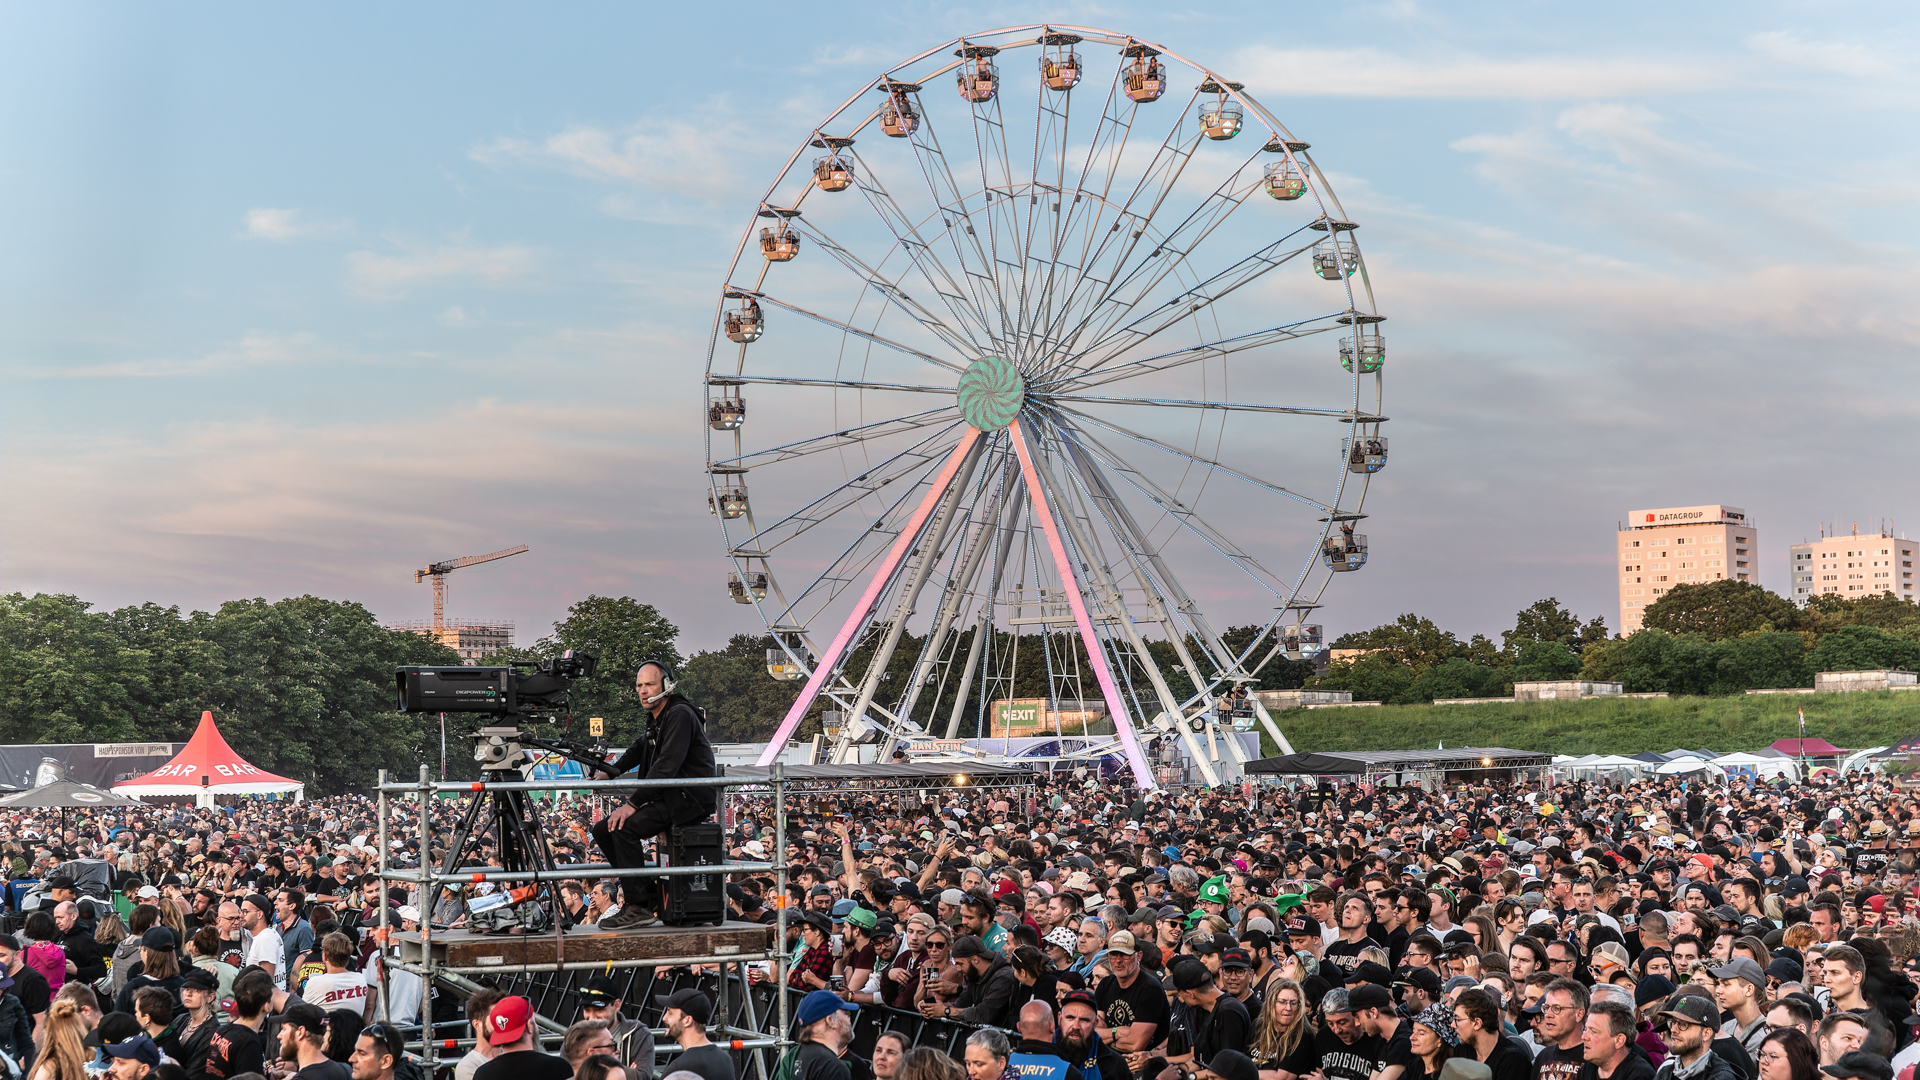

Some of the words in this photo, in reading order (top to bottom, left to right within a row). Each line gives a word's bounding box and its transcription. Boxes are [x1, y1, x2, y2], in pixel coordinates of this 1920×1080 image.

[1659, 511, 1703, 521] DATAGROUP
[1011, 709, 1036, 721] EXIT
[591, 724, 602, 733] 14
[153, 763, 198, 777] BAR
[214, 763, 262, 777] BAR
[1875, 853, 1888, 863] PAR
[1013, 1064, 1055, 1076] URITY
